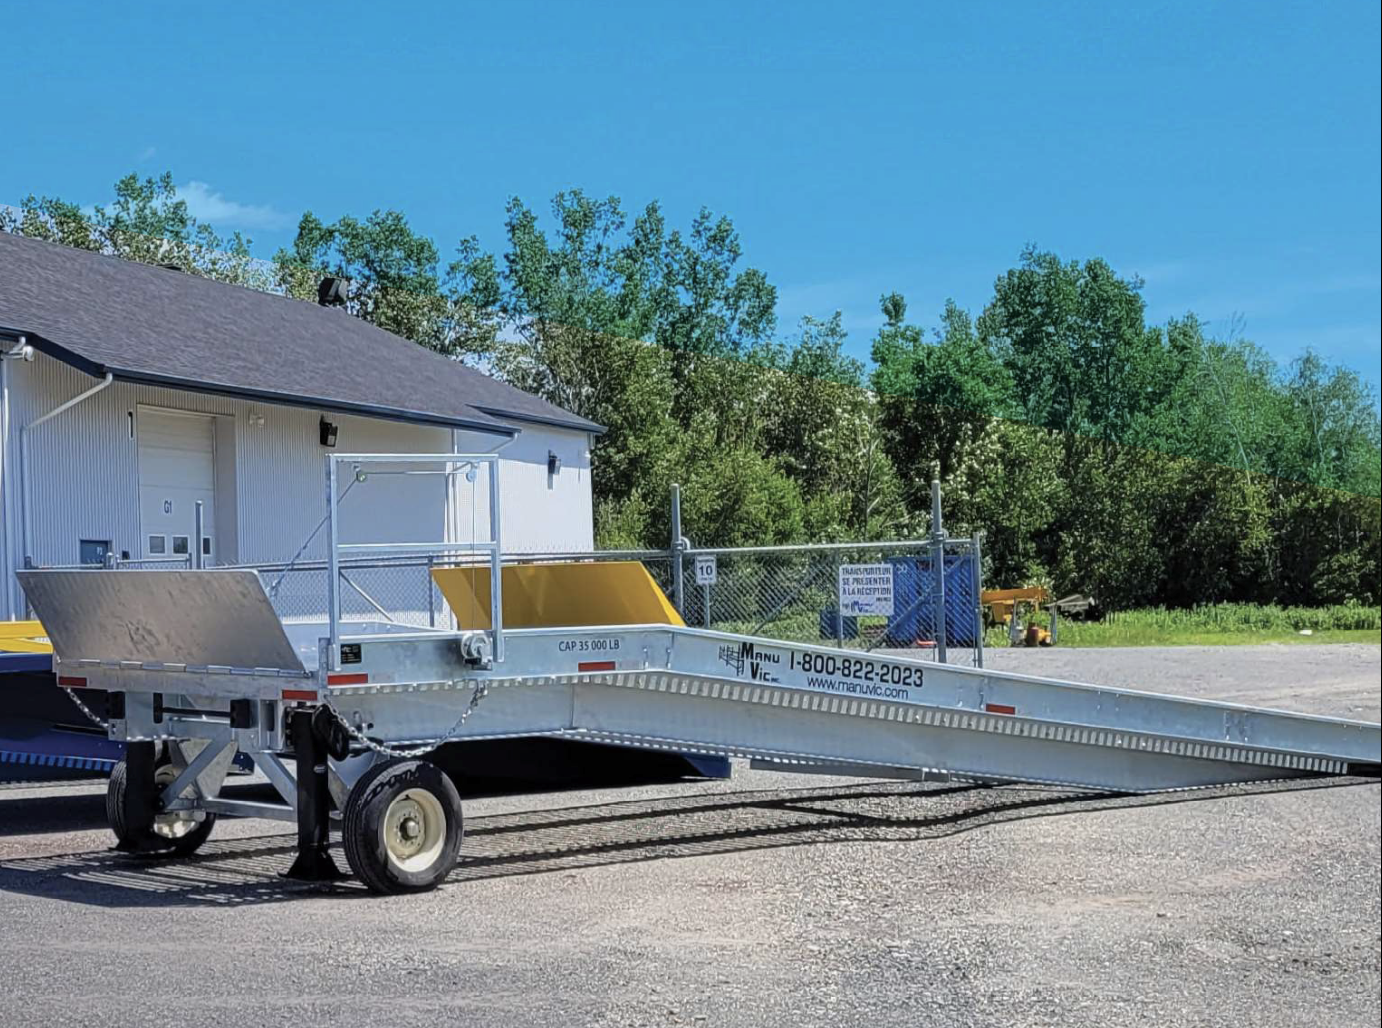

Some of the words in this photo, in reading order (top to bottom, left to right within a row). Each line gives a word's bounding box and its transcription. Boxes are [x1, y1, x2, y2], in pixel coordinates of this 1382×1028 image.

[699, 565, 713, 576] 10
[558, 641, 577, 651] CAP
[579, 640, 589, 651] 35
[591, 640, 607, 650] 000
[609, 639, 620, 650] LB
[807, 676, 909, 700] www.manuvic.com
